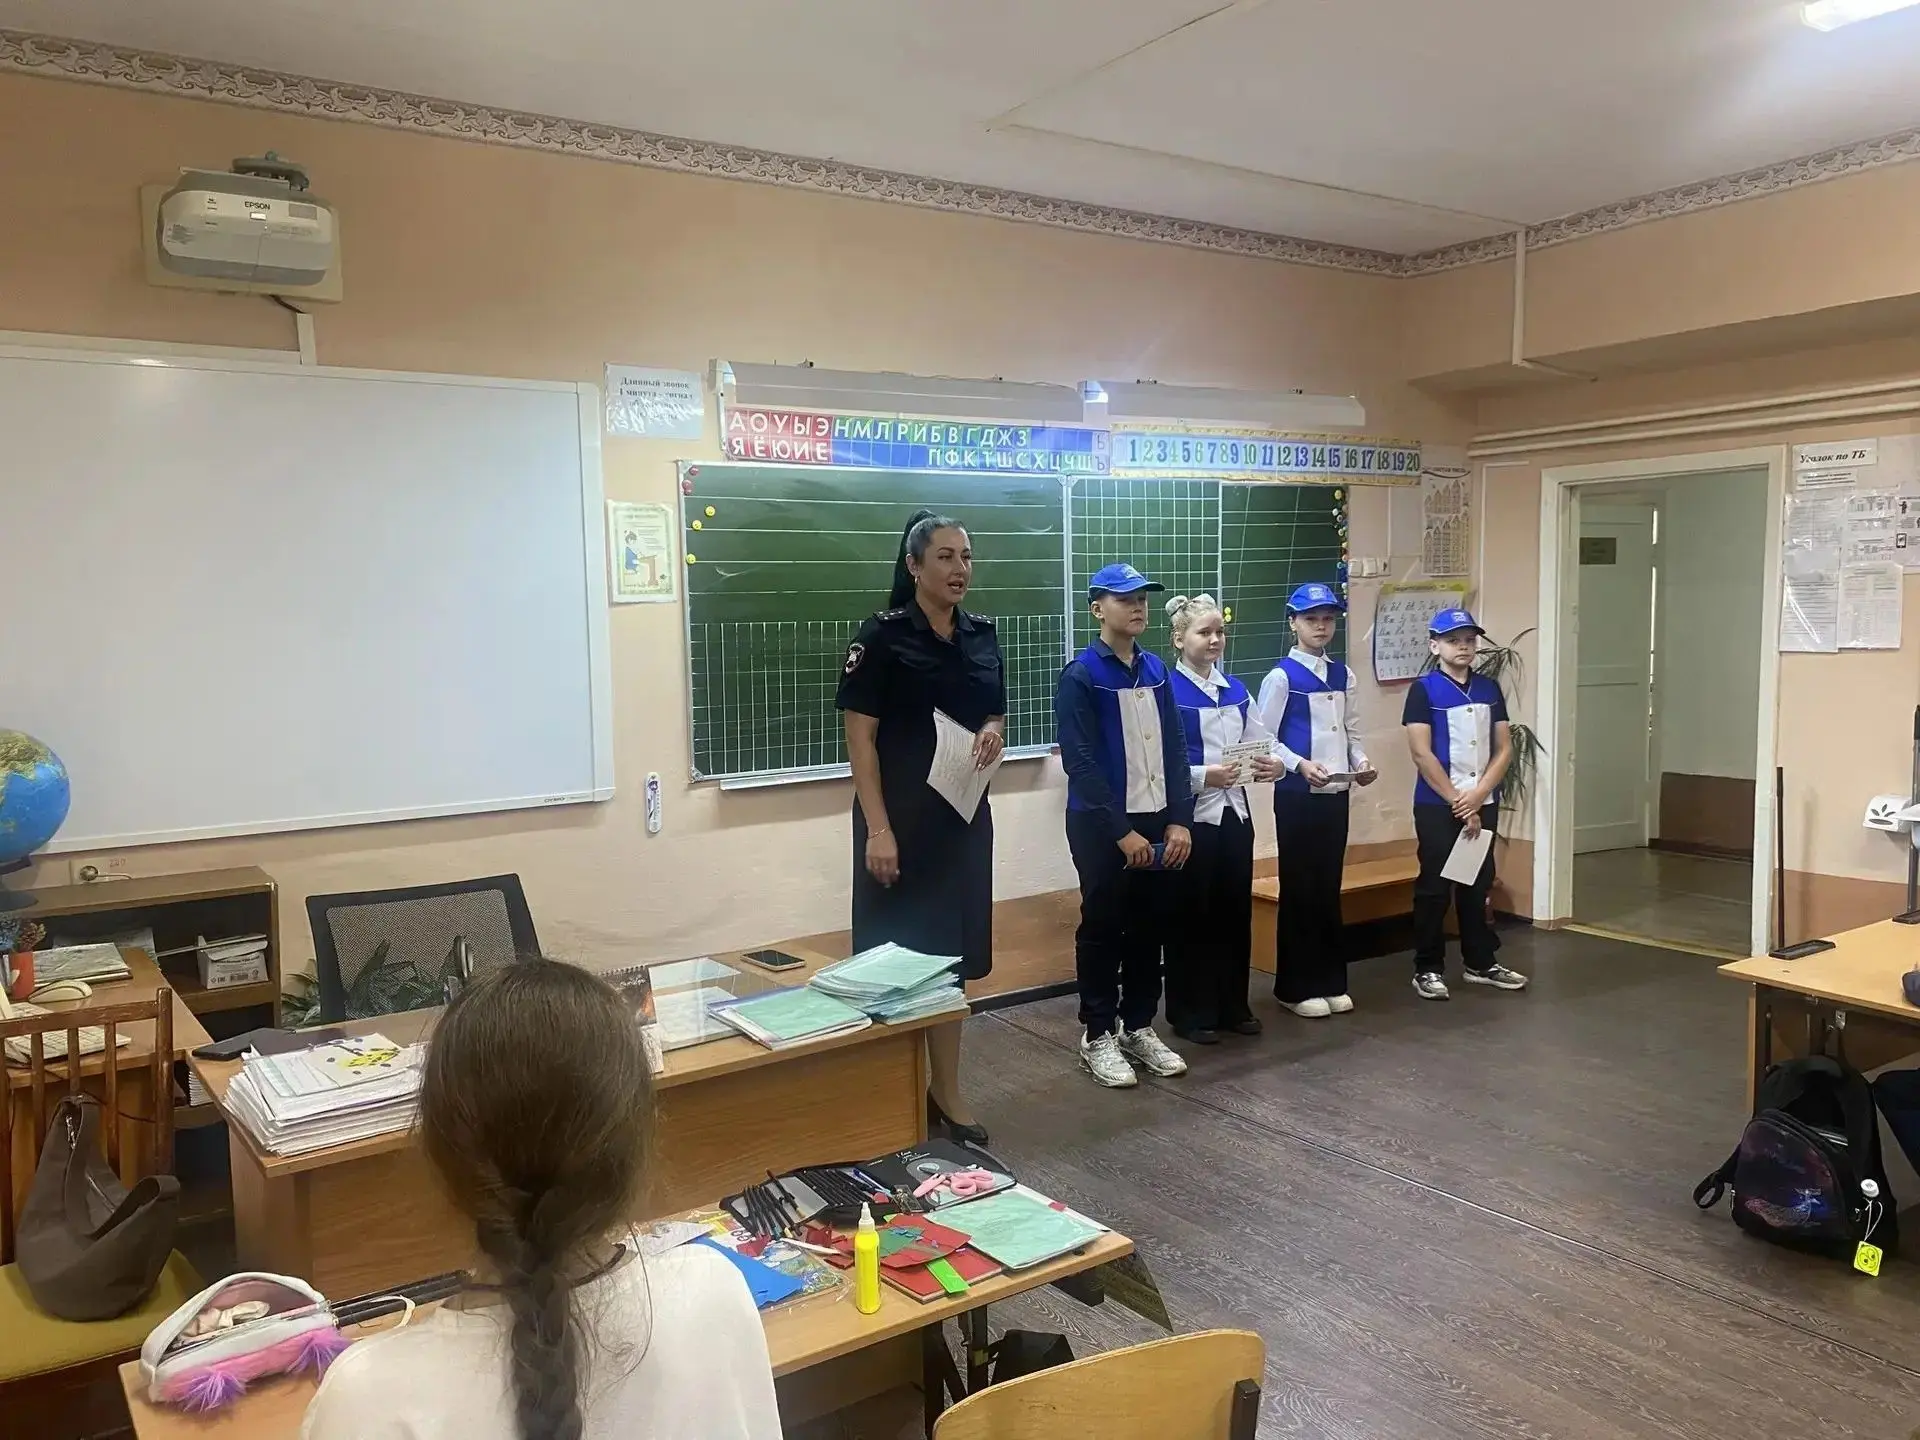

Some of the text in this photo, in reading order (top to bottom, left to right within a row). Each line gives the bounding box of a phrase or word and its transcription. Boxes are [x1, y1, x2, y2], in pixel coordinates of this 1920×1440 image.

[244, 201, 271, 210] EPSON
[1130, 439, 1420, 471] 1 2 3 4 5 6 7 8 9 10 11 12 13 14 15 16 17 18 19 20
[1836, 453, 1849, 461] по
[1852, 449, 1867, 459] ТБ
